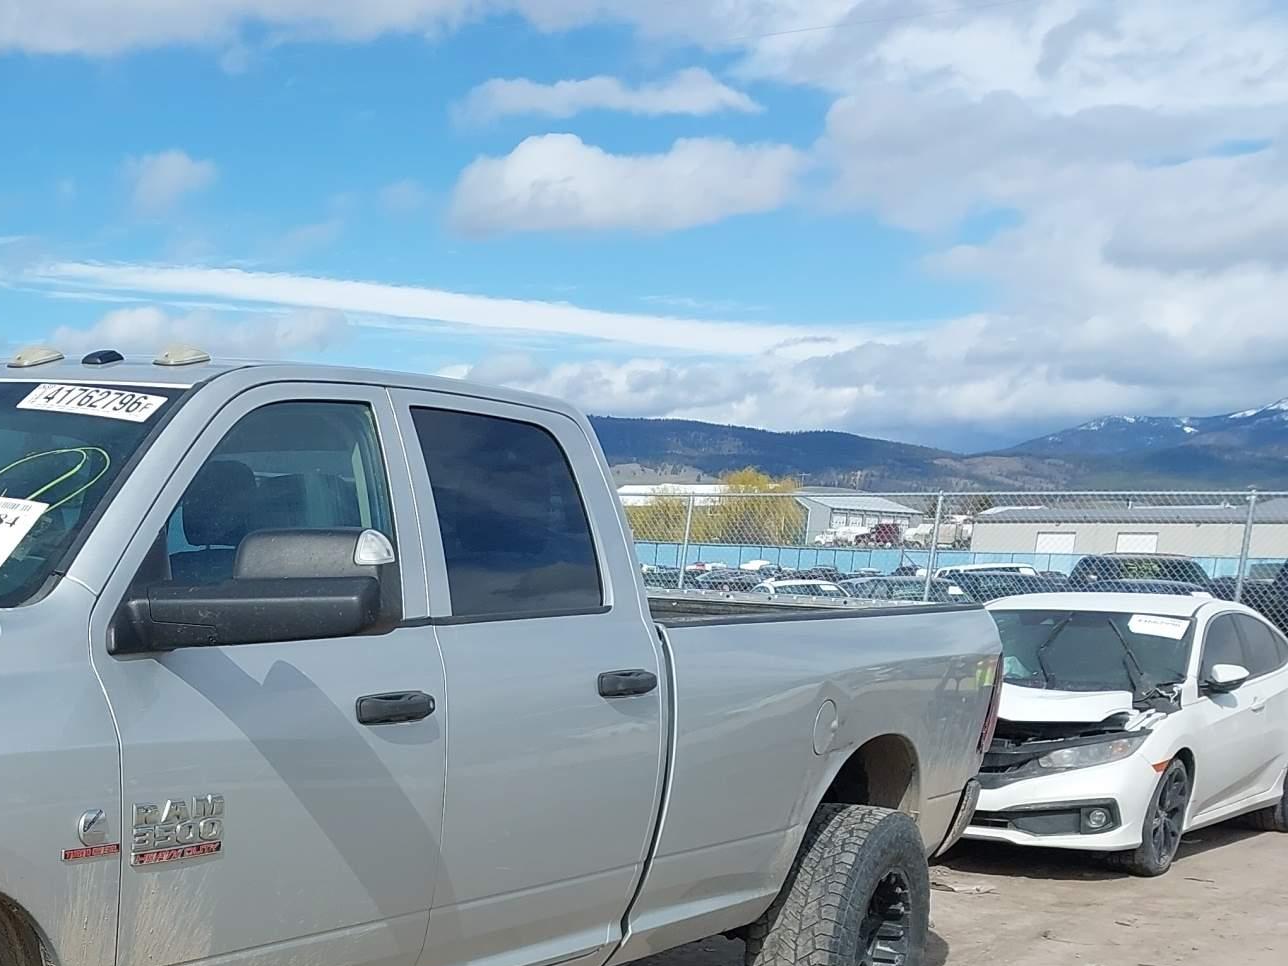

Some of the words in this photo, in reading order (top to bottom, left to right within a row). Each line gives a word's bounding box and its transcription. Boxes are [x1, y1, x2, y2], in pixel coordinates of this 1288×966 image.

[43, 386, 148, 413] 41762796
[132, 794, 224, 826] RAM
[132, 817, 224, 852] 3500
